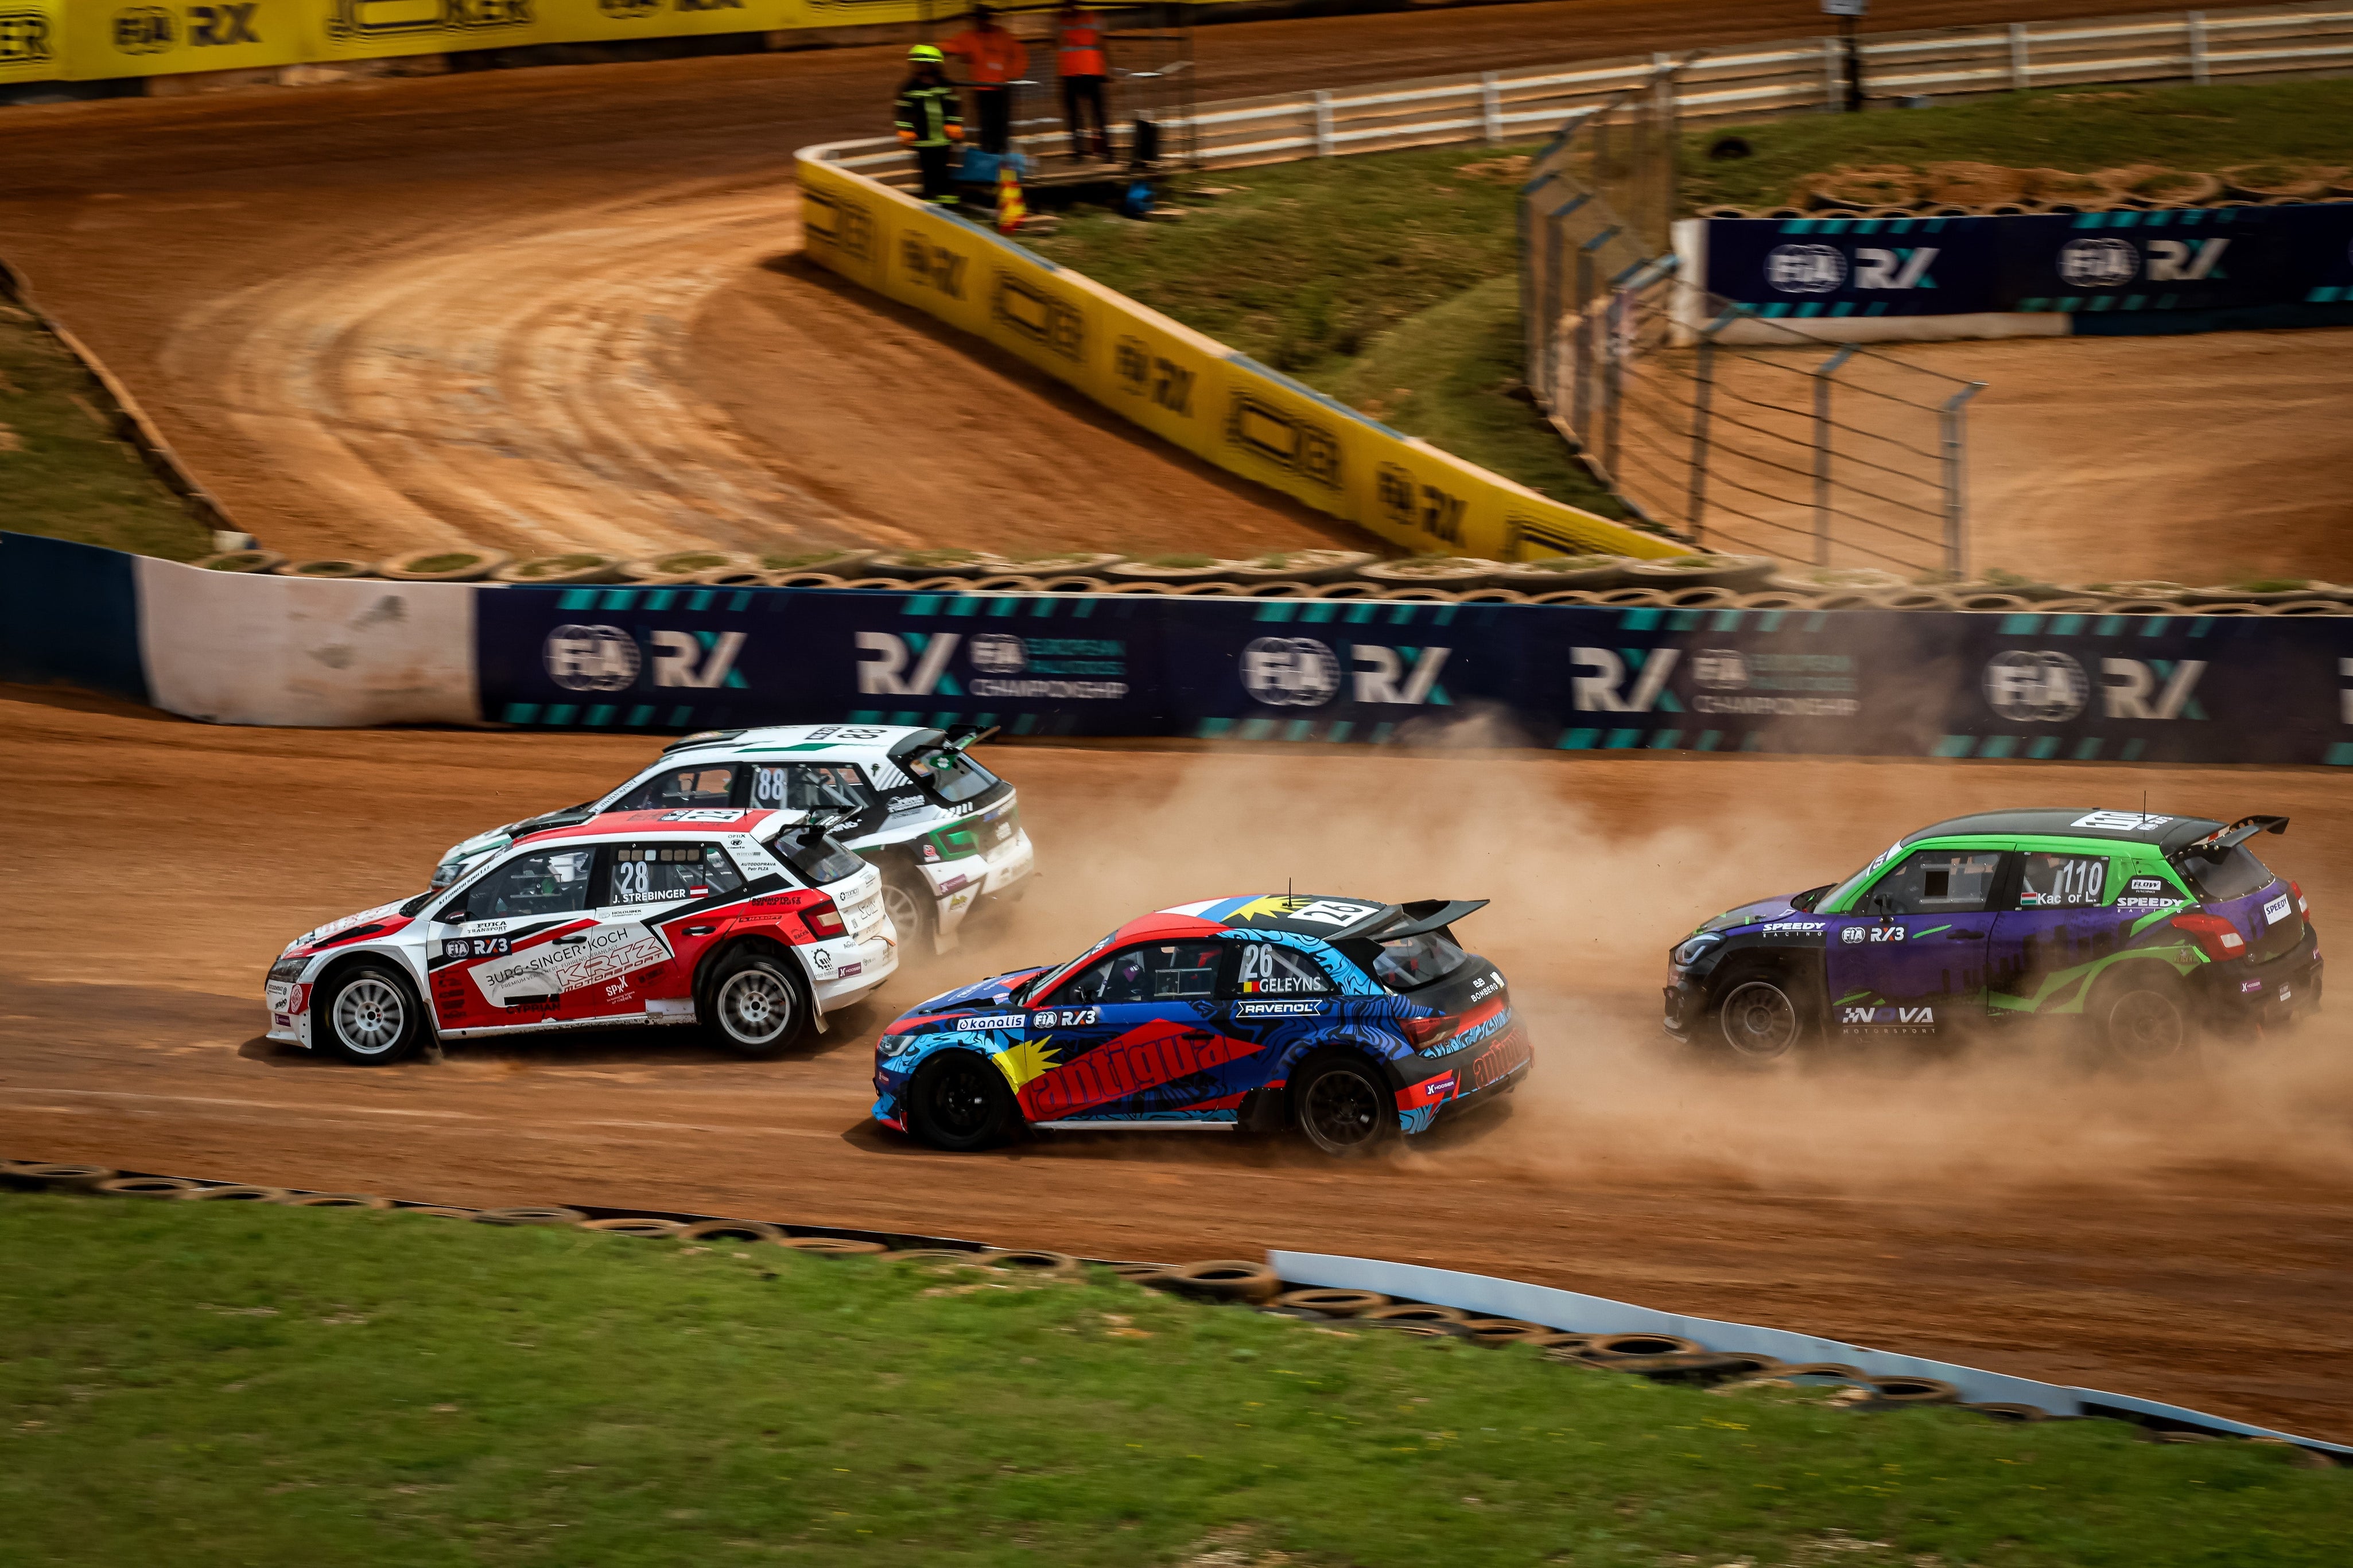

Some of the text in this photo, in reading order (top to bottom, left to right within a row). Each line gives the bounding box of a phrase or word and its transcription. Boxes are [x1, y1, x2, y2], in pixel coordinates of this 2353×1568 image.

[188, 2, 262, 47] RX
[1854, 247, 1940, 290] RX
[2147, 239, 2230, 281] RX
[545, 631, 749, 688] FIA RX
[855, 631, 964, 695] RX
[1242, 644, 1453, 705] FIA RX
[1570, 647, 1686, 712] RX
[1986, 657, 2210, 720] FIA RX
[758, 769, 785, 800] 88
[620, 862, 649, 894] 28
[2063, 859, 2103, 896] 110
[613, 889, 686, 904] J. STREBINGER
[2085, 891, 2096, 902] L.
[2117, 897, 2184, 907] SPEEDY
[1303, 904, 1364, 922] 26
[2265, 898, 2288, 915] SPEEDY
[468, 925, 507, 934] TRANSPORT
[1762, 923, 1826, 932] SPEEDY
[1842, 926, 1905, 942] FIA RX3
[447, 938, 508, 956] FIA RX3
[555, 937, 663, 987] KRTZ
[1245, 944, 1273, 979] 26
[563, 952, 664, 993] MOTORSPORT
[500, 978, 527, 990] PREMIUM
[1259, 976, 1321, 992] GELEYNS
[1470, 983, 1498, 1002] BOMBERG
[506, 1002, 561, 1014] CYPRIAN
[1245, 1004, 1308, 1013] RAVENOL
[970, 1016, 1022, 1029] kanalis
[1034, 1010, 1097, 1026] FIA RX3
[1035, 1030, 1232, 1114] antigua
[1434, 1080, 1454, 1091] HOOSIER
